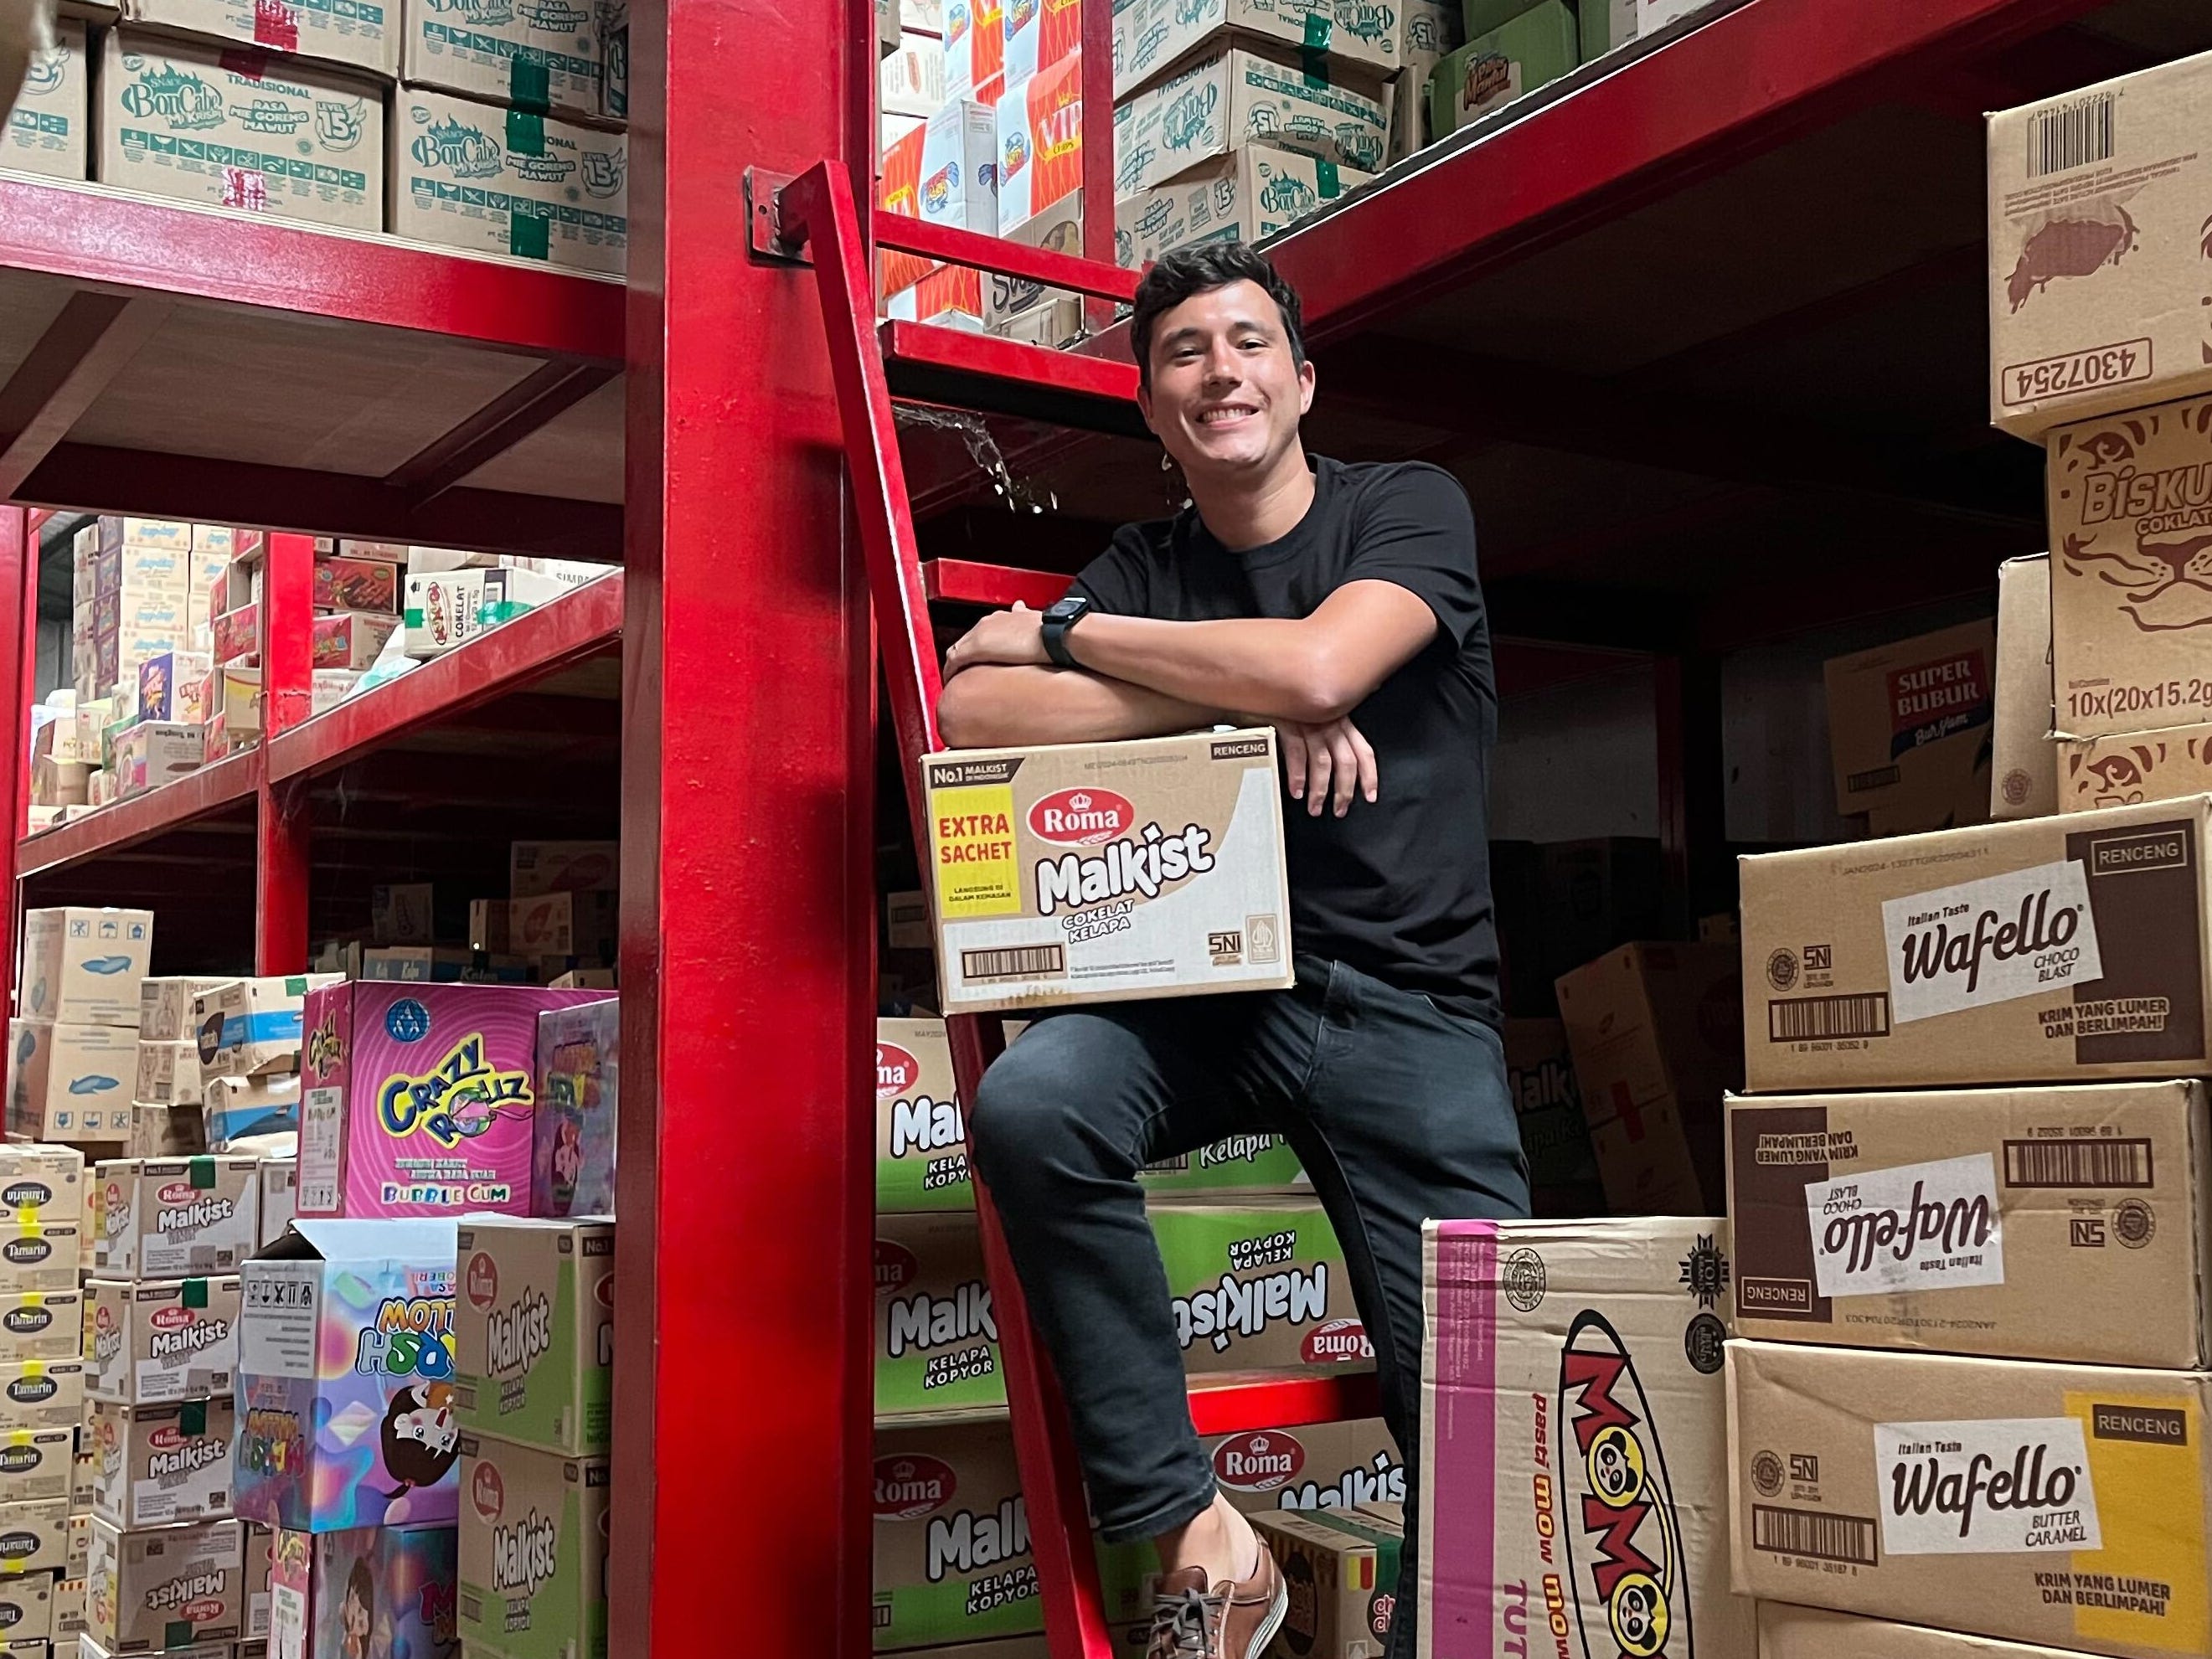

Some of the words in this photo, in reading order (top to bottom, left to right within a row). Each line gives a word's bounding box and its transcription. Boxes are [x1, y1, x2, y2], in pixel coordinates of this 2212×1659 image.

[529, 18, 576, 32] MAWUT
[227, 73, 312, 100] TRADISIONAL
[130, 82, 220, 118] BonCabe
[252, 99, 288, 111] RASA
[229, 106, 252, 120] MIE
[255, 110, 309, 123] GORENG
[318, 111, 349, 140] 15
[243, 121, 296, 135] MAWUT
[418, 135, 499, 168] BonCabe
[518, 169, 565, 183] MAWUT
[585, 158, 614, 186] 15
[2016, 348, 2137, 399] 4307254
[455, 585, 466, 638] COKELAT
[1898, 659, 1972, 695] SUPER
[1897, 681, 1979, 718] BUBUR
[1214, 744, 1266, 757] RENCENG
[934, 766, 963, 784] No.1
[965, 763, 1008, 775] MALKIST
[939, 813, 1010, 837] EXTRA
[1044, 808, 1121, 833] Roma
[941, 841, 1013, 864] SACHET
[2099, 842, 2180, 866] RENCENG
[1035, 822, 1214, 915] Malkist
[948, 893, 975, 903] DALAM
[976, 891, 1012, 901] KEMASAN
[1063, 899, 1136, 930] COKELAT
[1907, 907, 1941, 928] Italian
[1941, 902, 1970, 919] Taste
[1069, 917, 1131, 945] KELAPA
[1901, 888, 2079, 994] Wafello
[1209, 933, 1242, 956] SNI
[1803, 945, 1832, 970] SNI
[2033, 946, 2081, 970] CHOCO
[2037, 961, 2075, 983] BLAST
[2037, 1005, 2073, 1026] KRIM
[2074, 1001, 2114, 1021] YANG
[2117, 997, 2169, 1018] LUMER
[2044, 1021, 2074, 1039] DAN
[2075, 1012, 2164, 1036] BERLIMPAH!
[383, 1038, 490, 1132] CRAZY
[1199, 1134, 1272, 1168] Kelapa
[1760, 1132, 1825, 1148] BERLIMPAH!
[1827, 1130, 1853, 1146] DAN
[1756, 1147, 1793, 1164] LUMER
[1794, 1146, 1828, 1162] YANG
[1829, 1144, 1859, 1160] KRIM
[925, 1169, 971, 1189] KOPY
[384, 1186, 462, 1204] BUBBLE
[470, 1186, 507, 1203] GUM
[1828, 1184, 1859, 1201] BLAST
[157, 1198, 233, 1234] Malkist
[1823, 1197, 1863, 1215] CHOCO
[1823, 1180, 1990, 1275] Wafello
[2070, 1219, 2106, 1247] SNI
[8, 1243, 47, 1256] Tamarin
[1230, 1230, 1297, 1256] KOPYOR
[1232, 1247, 1292, 1270] KELAPA
[1919, 1255, 1946, 1272] Taste
[1949, 1254, 1983, 1270] Italian
[1704, 1257, 1715, 1291] TOP
[1172, 1261, 1328, 1352] Malkist
[1746, 1284, 1807, 1305] RENCENG
[150, 1318, 228, 1358] Malkist
[487, 1285, 549, 1378] Malkist
[928, 1346, 990, 1373] KELAPA
[924, 1360, 994, 1389] KOPYOR
[12, 1383, 53, 1397] Tamarin
[1531, 1392, 1550, 1469] pasti
[2097, 1414, 2182, 1437] RENCENG
[148, 1437, 226, 1479] Malkist
[1898, 1442, 1933, 1455] Italian
[1934, 1440, 1962, 1454] Taste
[1225, 1451, 1293, 1476] Roma
[1790, 1453, 1819, 1483] SNI
[1891, 1443, 2077, 1538] Wafello
[1533, 1473, 1555, 1565] mow
[2031, 1510, 2081, 1530] BUTTER
[2024, 1527, 2088, 1548] CARAMEL
[492, 1506, 555, 1596] Malkist
[146, 1569, 226, 1610] Malkist
[971, 1564, 1037, 1598] KELAPA
[2034, 1572, 2072, 1588] KRIM
[2073, 1574, 2115, 1591] YANG
[2117, 1577, 2171, 1600] LUMER
[967, 1580, 1040, 1615] KOPYOR
[2042, 1589, 2073, 1605] DAN
[2075, 1591, 2166, 1616] BERLIMPAH!
[1503, 1578, 1528, 1659] TUT
